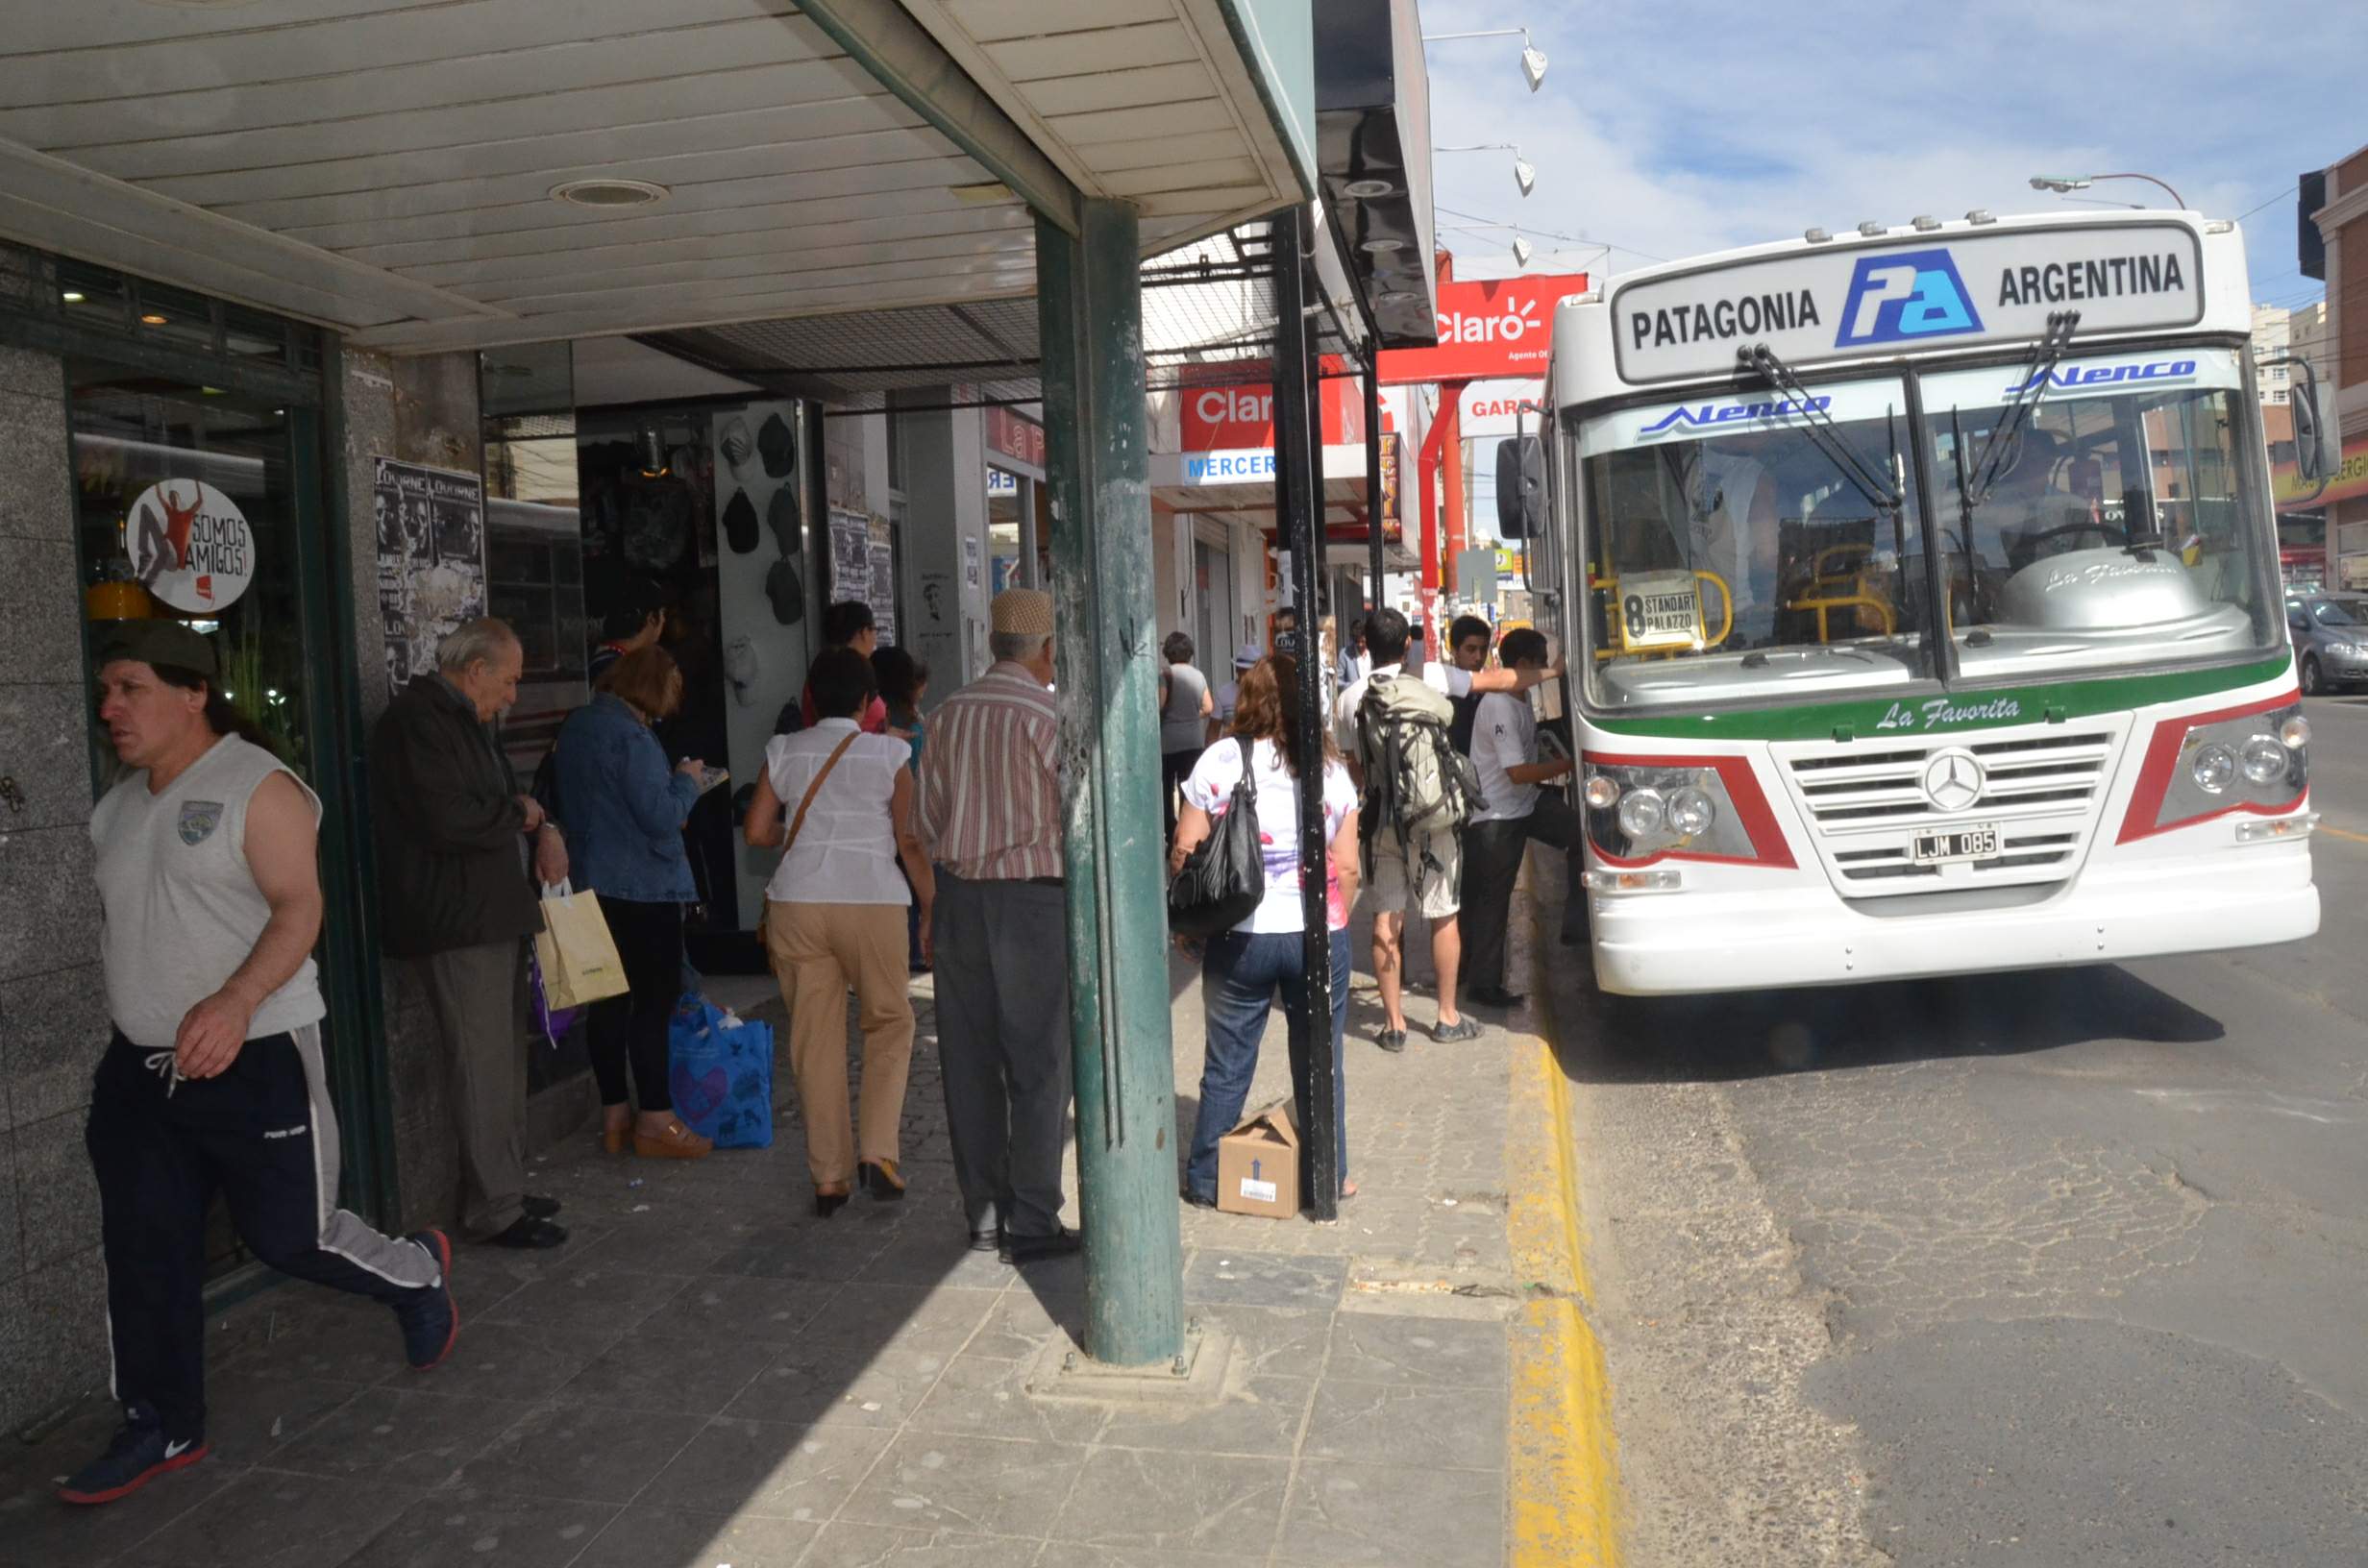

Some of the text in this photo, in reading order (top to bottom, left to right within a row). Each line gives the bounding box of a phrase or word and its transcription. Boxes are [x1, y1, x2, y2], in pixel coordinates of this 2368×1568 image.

[1632, 289, 1820, 350] PATAGONIA
[1999, 253, 2184, 306] ARGENTINA
[1437, 311, 1526, 344] Claro
[1508, 352, 1537, 361] Agente
[1196, 390, 1272, 423] Clar
[1189, 455, 1276, 478] MERCER
[192, 514, 246, 548] SOMOS
[185, 544, 247, 576] AMIGOS!
[1624, 594, 1646, 639] 8
[1645, 595, 1695, 614] STANDART
[1647, 613, 1691, 631] PALAZZO
[1876, 698, 2021, 729] La Favorita
[1916, 832, 1995, 859] LJM 085
